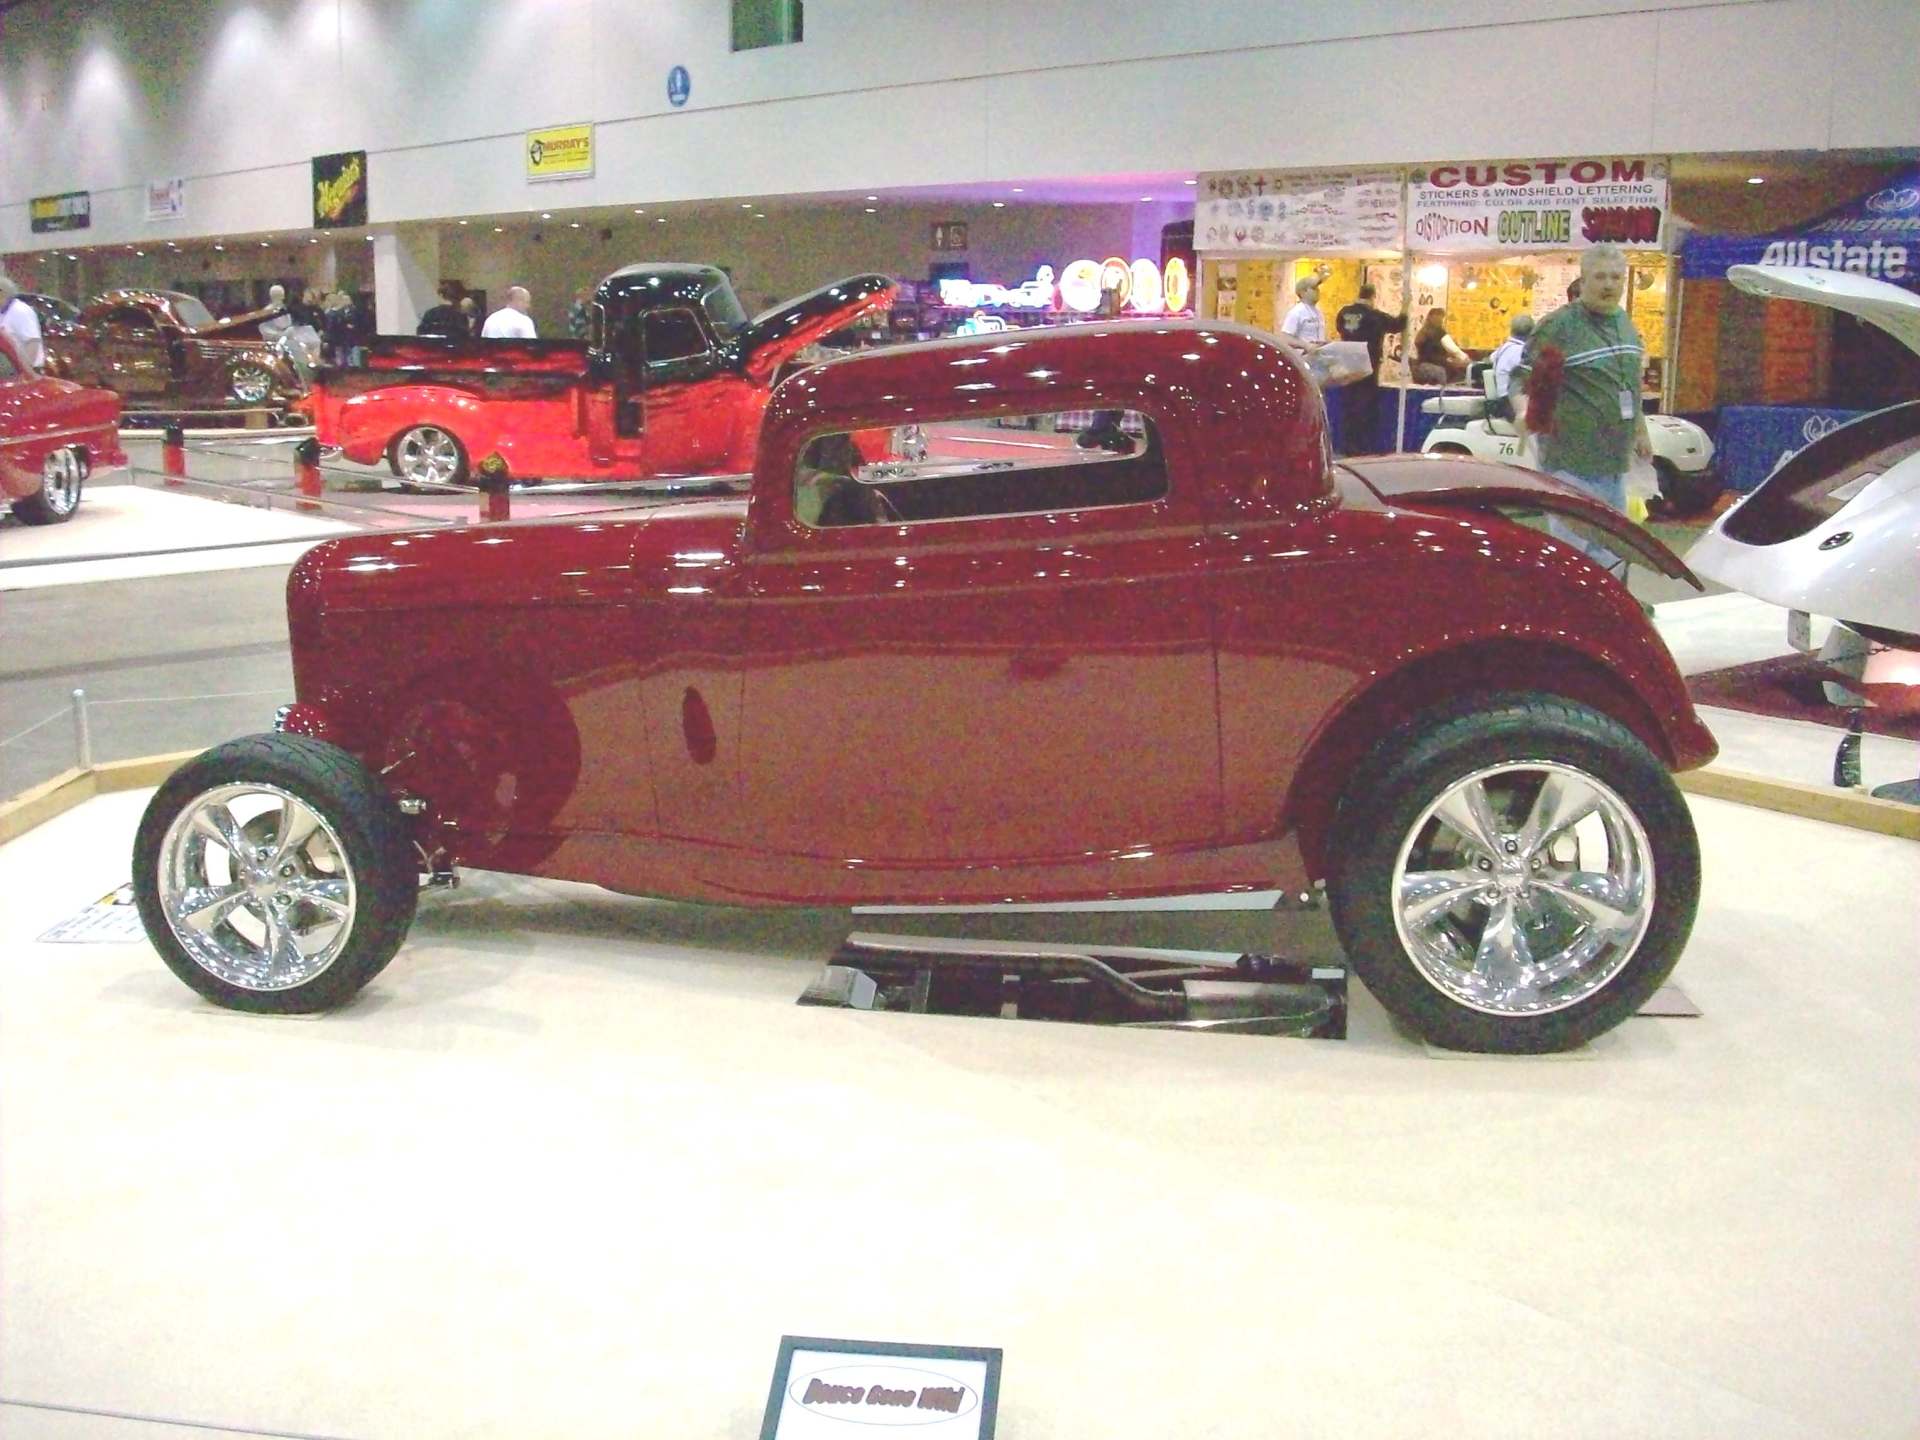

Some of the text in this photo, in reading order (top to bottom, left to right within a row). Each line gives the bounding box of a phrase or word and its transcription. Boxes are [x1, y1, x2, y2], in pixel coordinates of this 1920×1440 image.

[1430, 160, 1645, 188] CUSTOM
[1420, 184, 1653, 200] STICKERS & WINDSHIELD LETTERING
[1484, 198, 1523, 206] COLOR
[1527, 198, 1551, 206] AND
[1592, 195, 1658, 204] SELECTION
[1415, 212, 1489, 242] DISTORTION
[1497, 210, 1571, 244] OUTLINE
[1759, 239, 1907, 279] Allstate
[1499, 442, 1514, 456] 76
